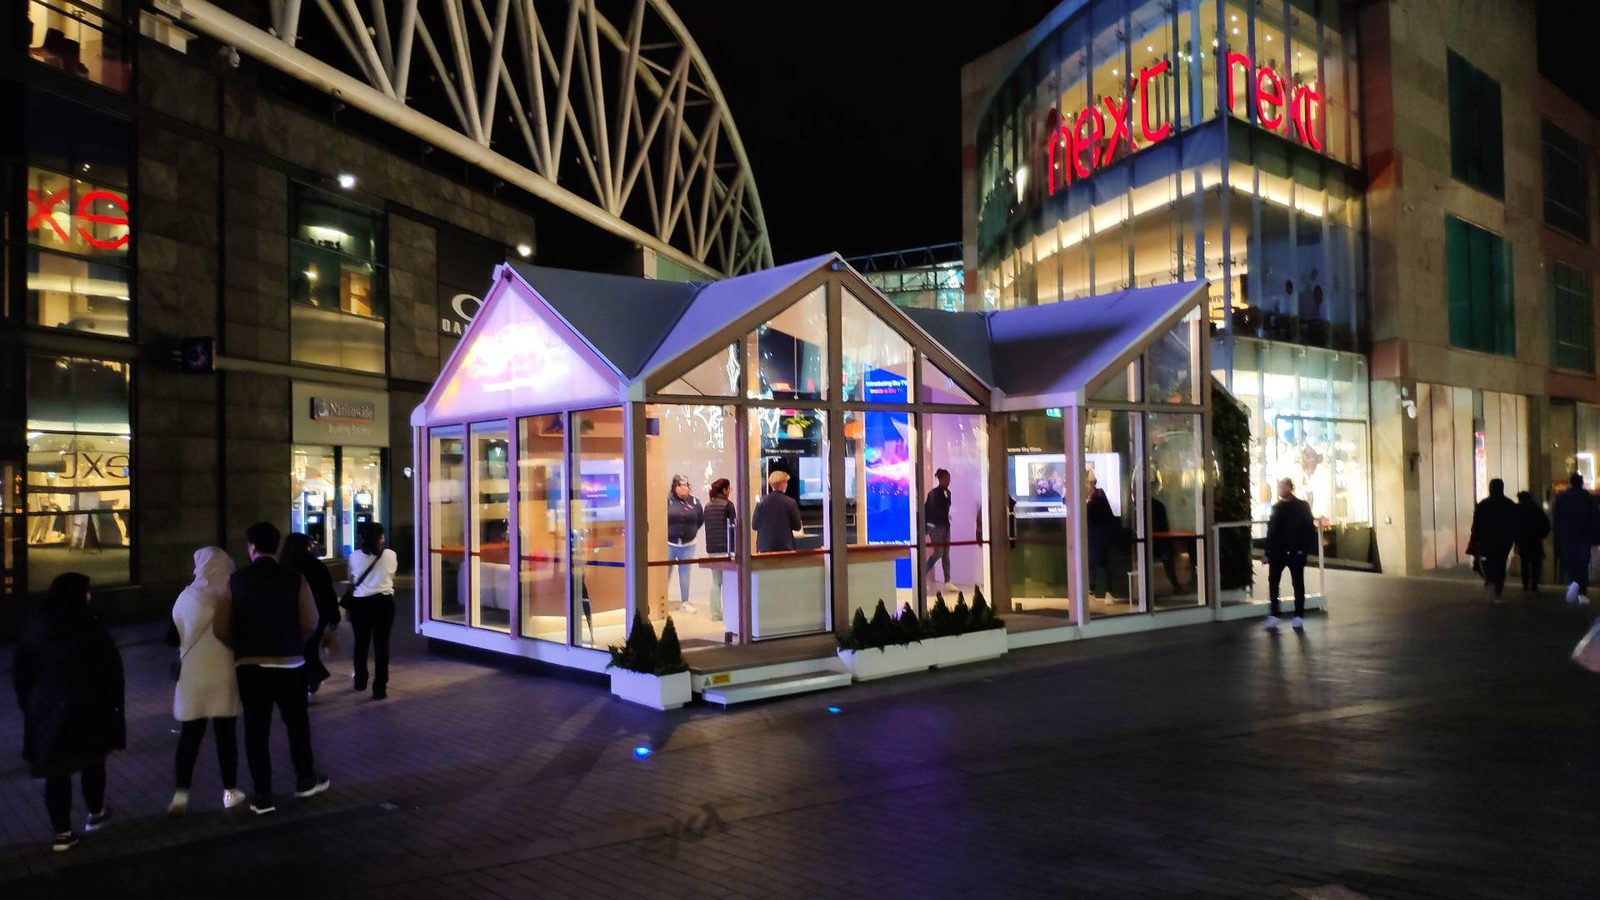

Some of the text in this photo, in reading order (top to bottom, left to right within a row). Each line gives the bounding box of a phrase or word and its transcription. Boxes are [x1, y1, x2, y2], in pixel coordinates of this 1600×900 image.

[1047, 59, 1171, 196] next
[1226, 52, 1323, 151] next
[441, 318, 470, 336] OA
[329, 401, 374, 419] Nationwide
